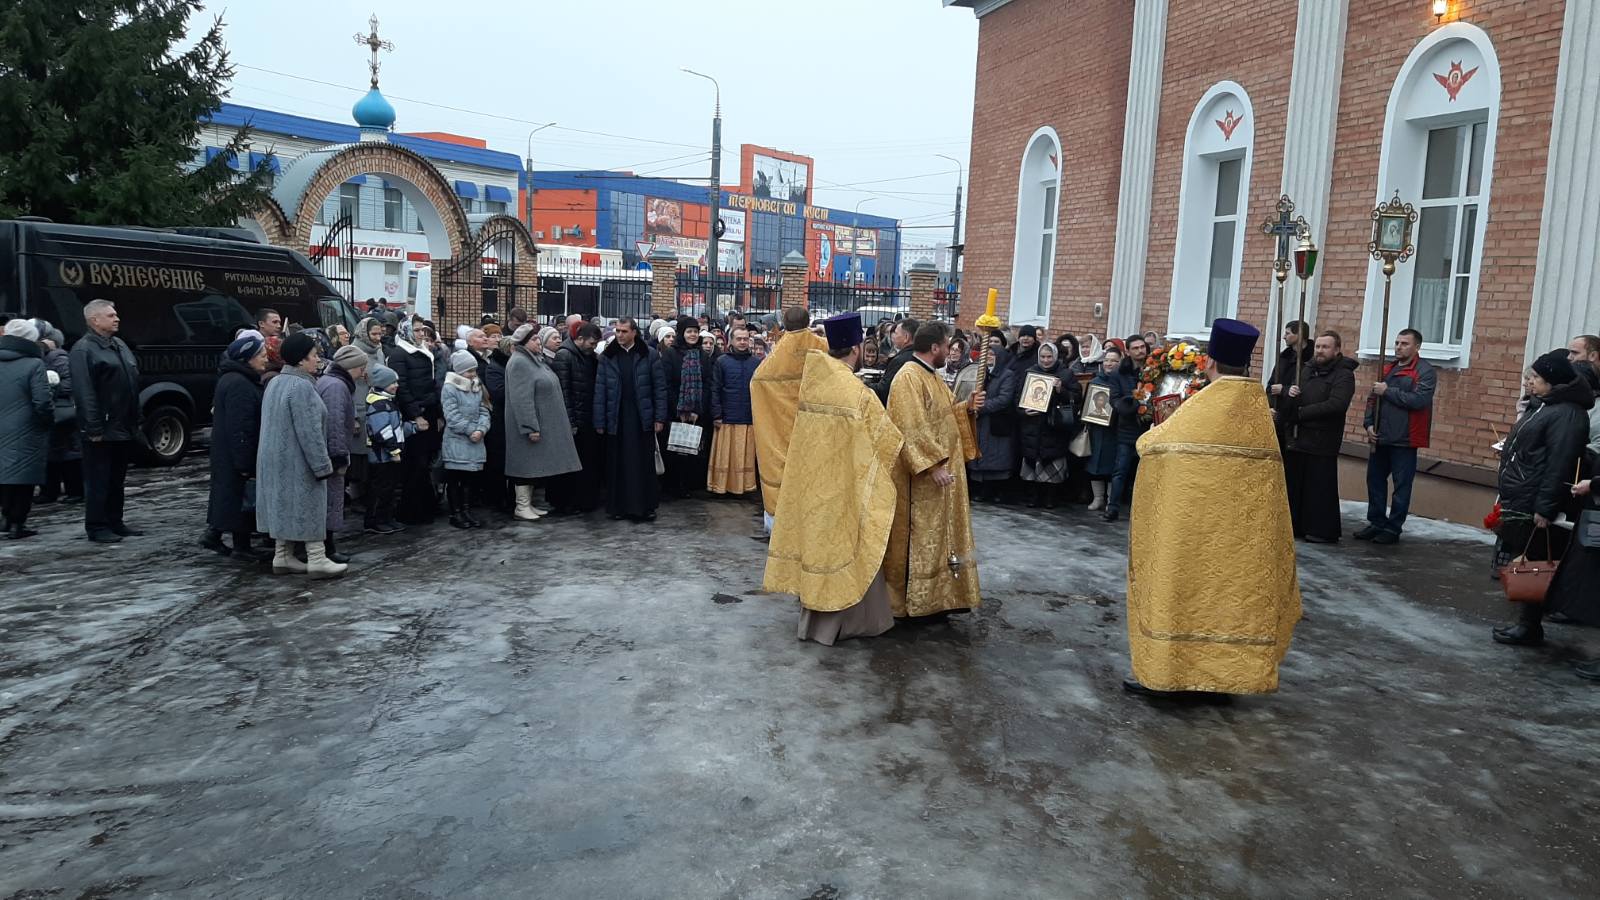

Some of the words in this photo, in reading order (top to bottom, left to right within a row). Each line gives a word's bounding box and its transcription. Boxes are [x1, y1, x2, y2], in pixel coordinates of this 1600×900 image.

[346, 245, 401, 257] МАГНИТ
[90, 262, 206, 291] ВОЗНЕСЕНИЕ
[224, 272, 276, 284] РИТУАЛЬНАЯ
[277, 276, 306, 286] СЛУЖБА
[264, 285, 300, 297] 73-93-93
